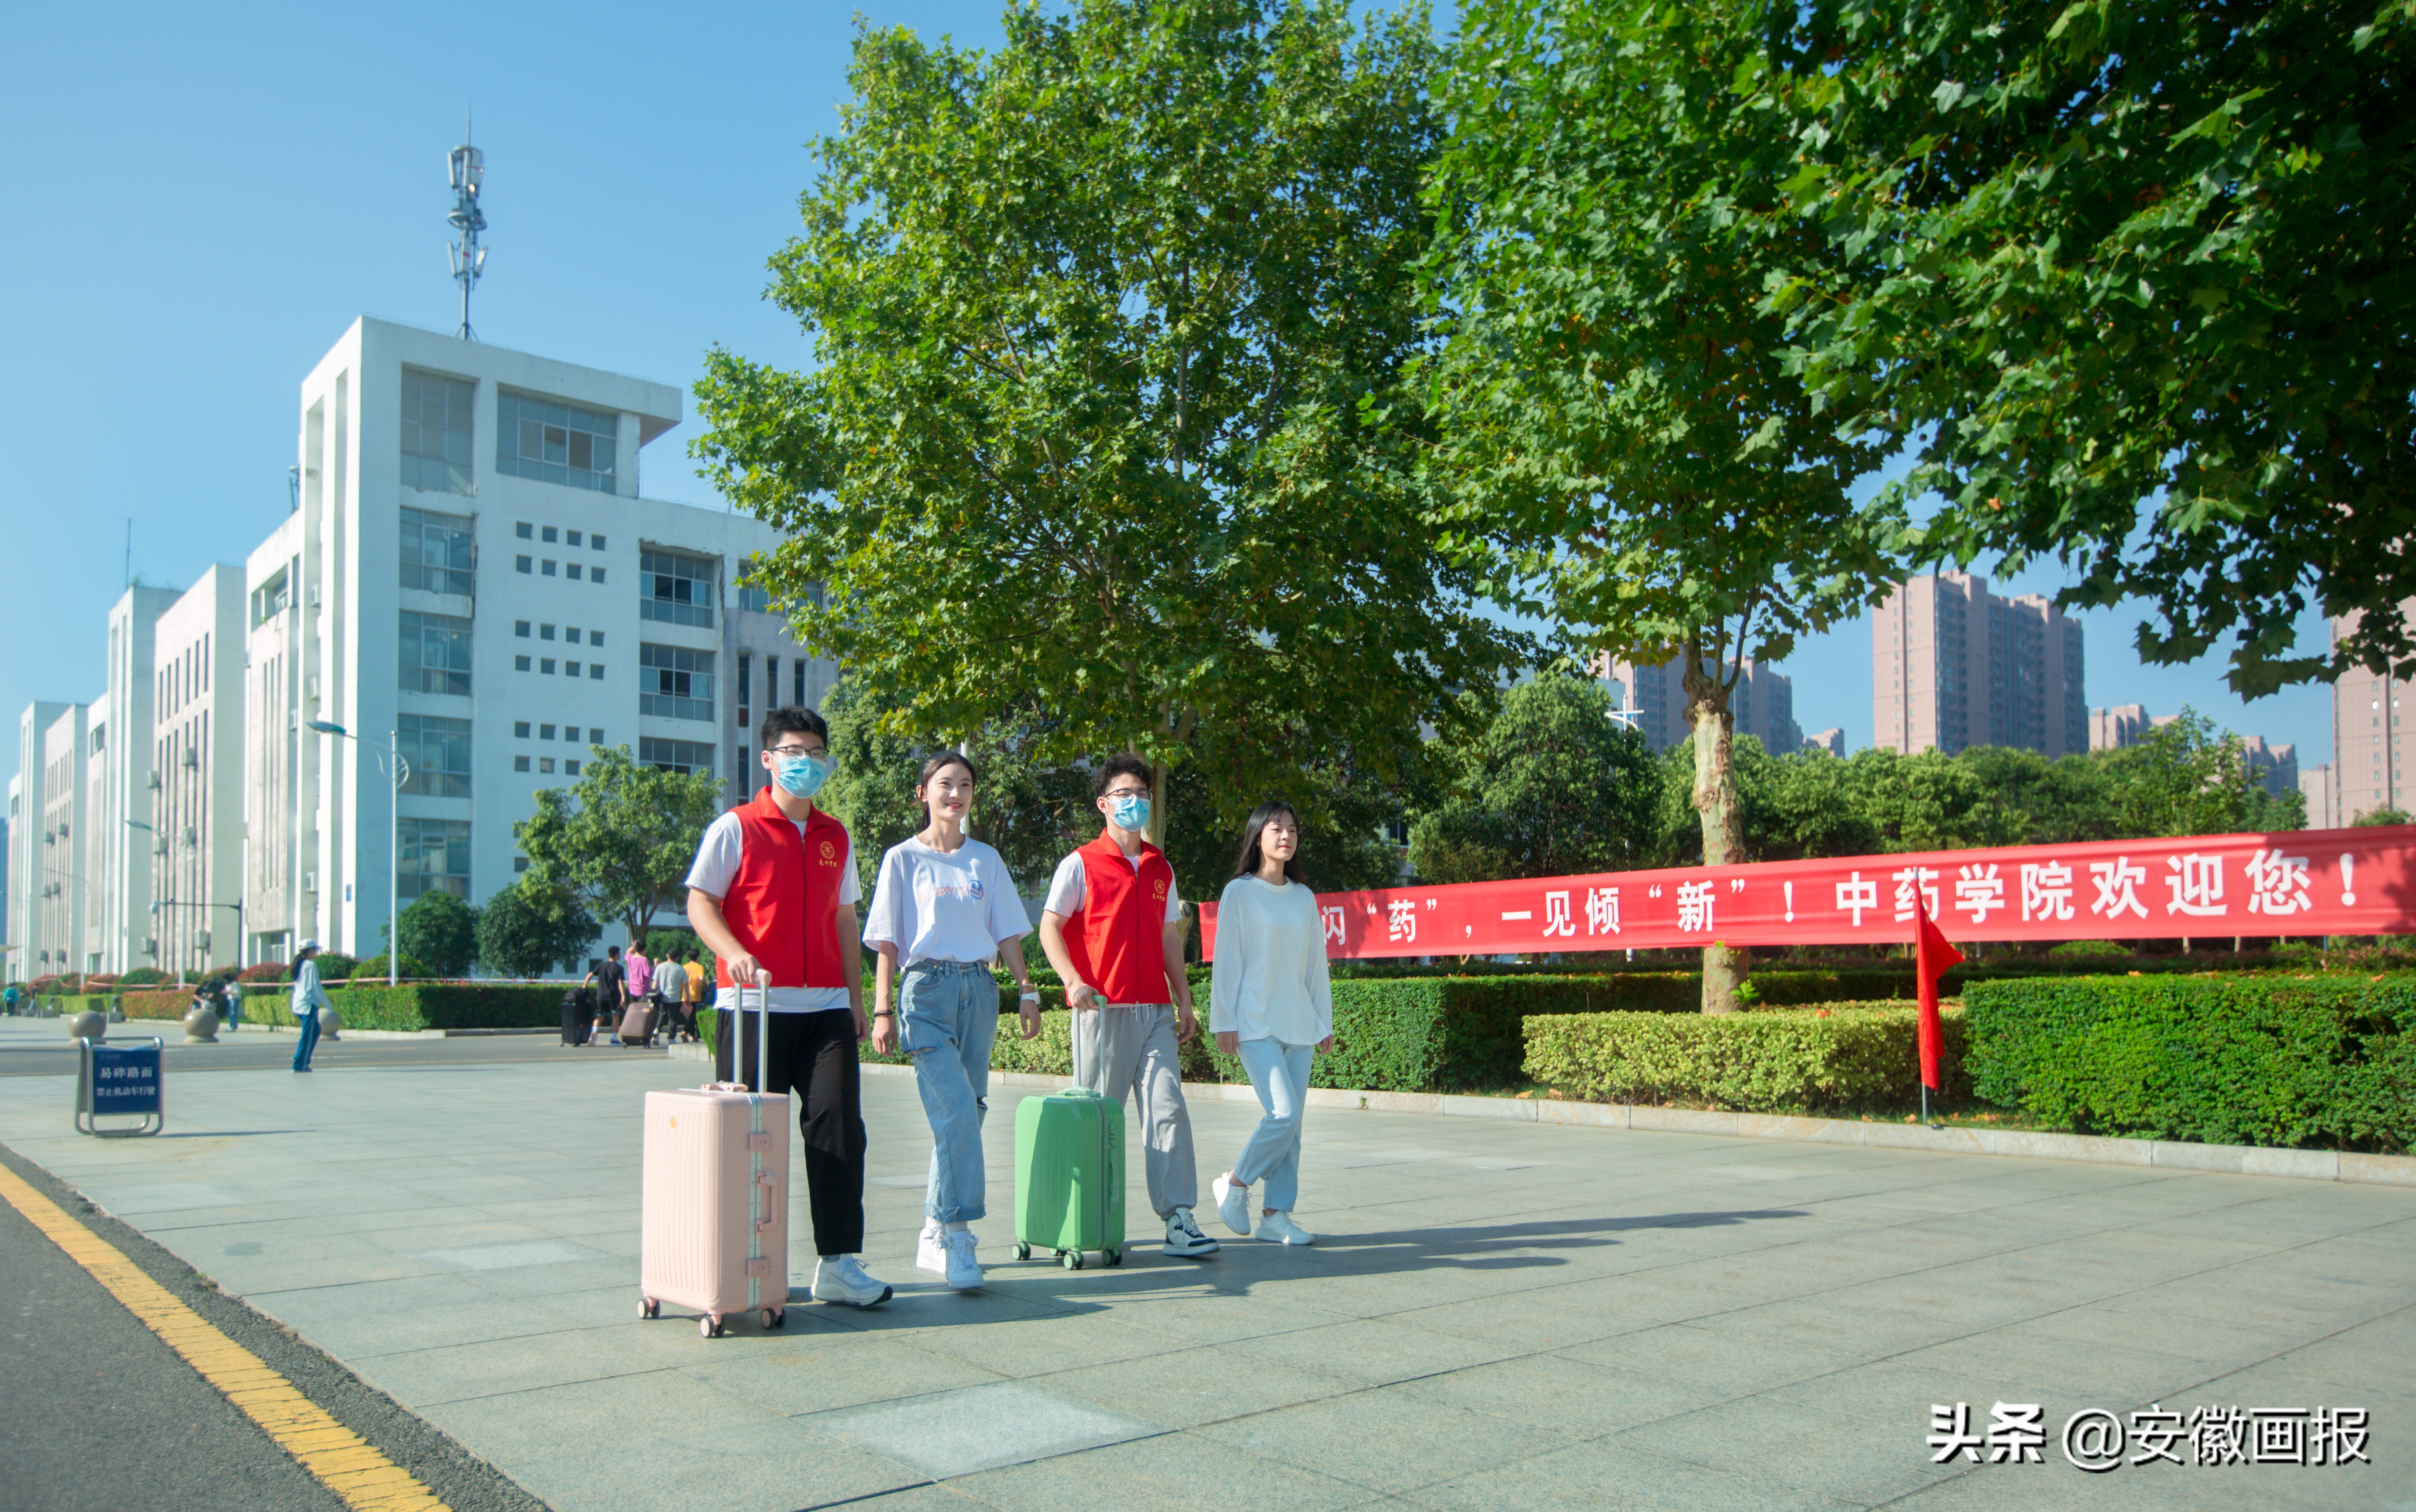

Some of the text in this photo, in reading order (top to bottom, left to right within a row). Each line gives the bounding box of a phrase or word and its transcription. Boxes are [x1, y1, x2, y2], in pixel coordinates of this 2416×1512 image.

[101, 1067, 153, 1079] 易碎路面
[97, 1086, 156, 1097] 禁止机动车行驶
